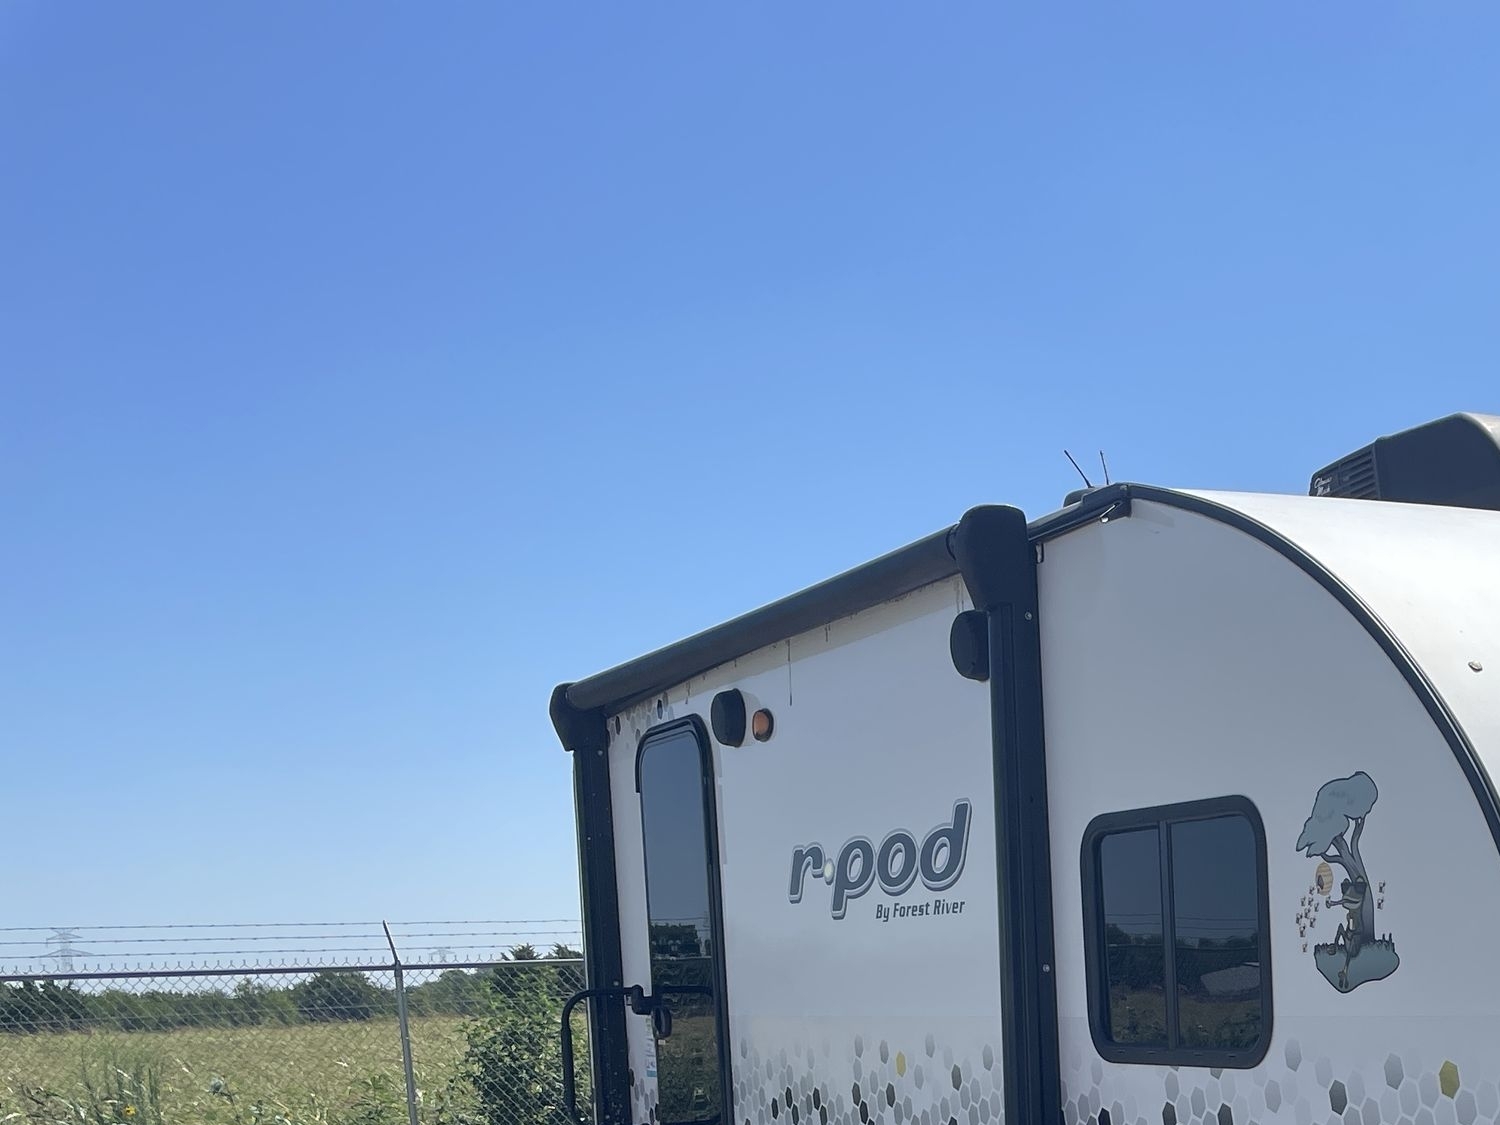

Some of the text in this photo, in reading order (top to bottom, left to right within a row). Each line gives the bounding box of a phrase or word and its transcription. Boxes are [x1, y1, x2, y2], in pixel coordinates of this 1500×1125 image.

[876, 899, 965, 922] By Forest River
